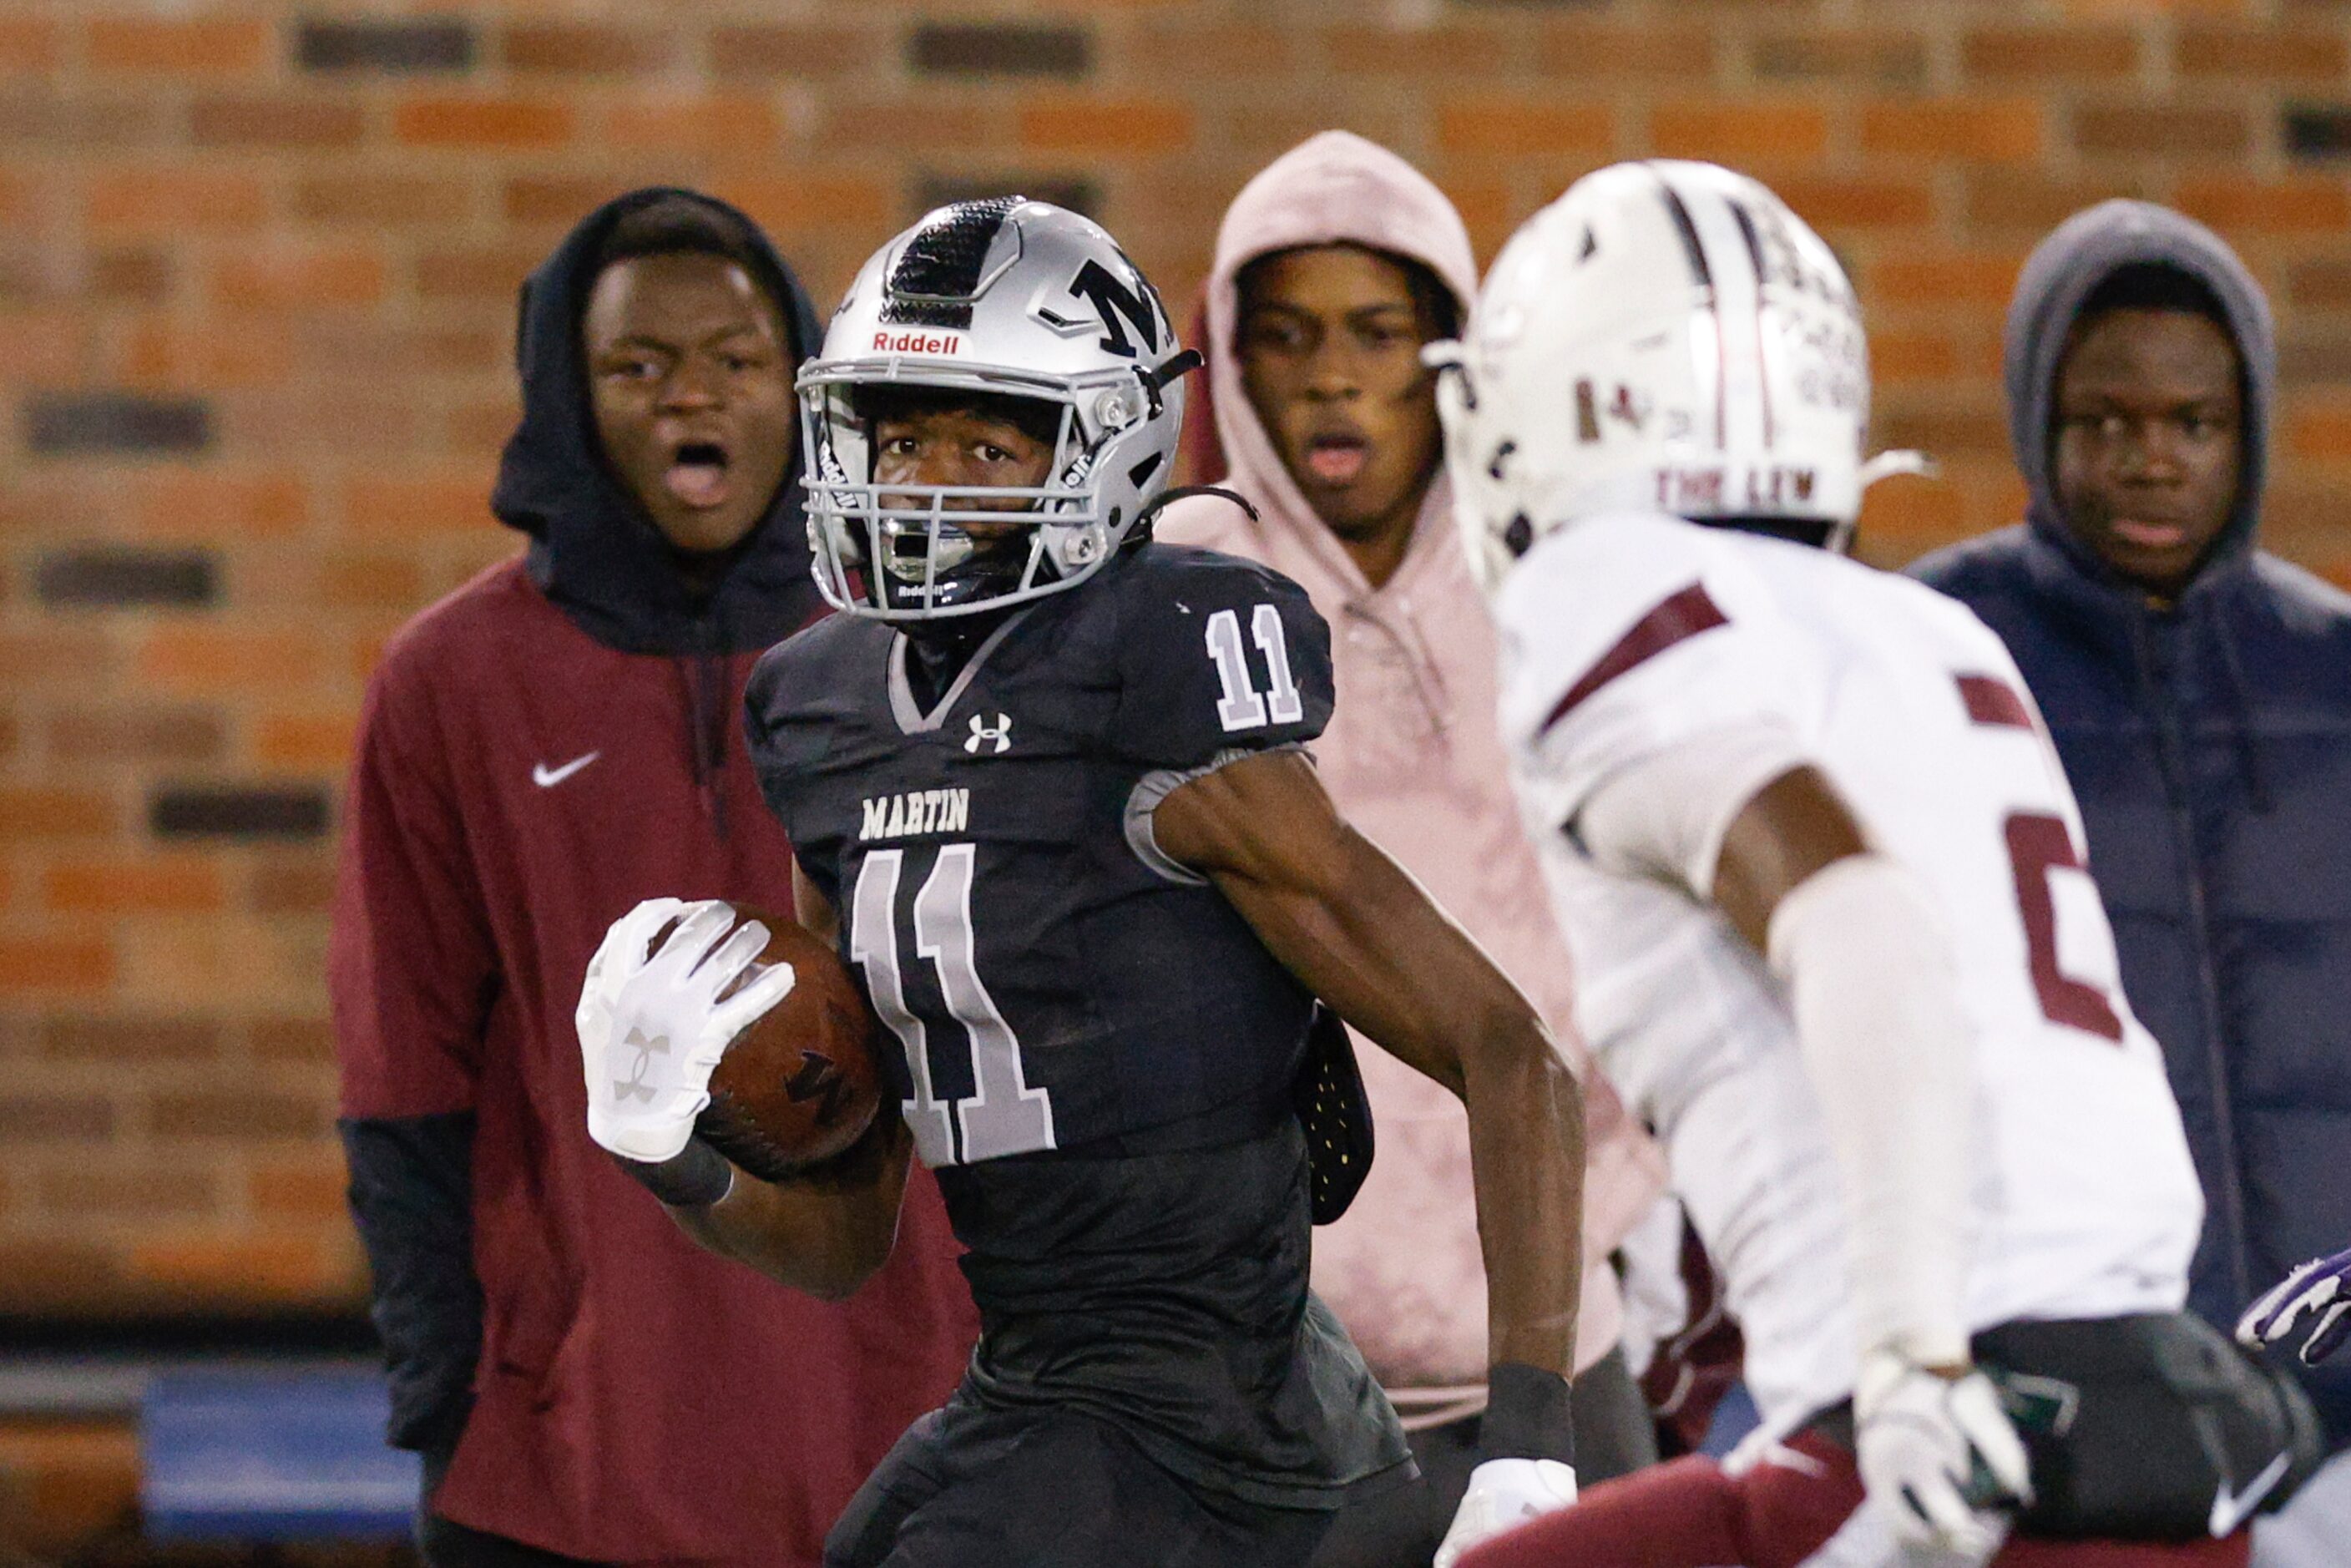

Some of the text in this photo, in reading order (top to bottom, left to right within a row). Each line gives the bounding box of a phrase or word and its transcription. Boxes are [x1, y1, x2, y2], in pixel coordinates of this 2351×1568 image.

[872, 332, 959, 355] Riddell
[897, 584, 943, 597] Riddll
[1205, 604, 1302, 732] 11
[858, 788, 969, 841] MARTIN
[851, 842, 1058, 1169] 11
